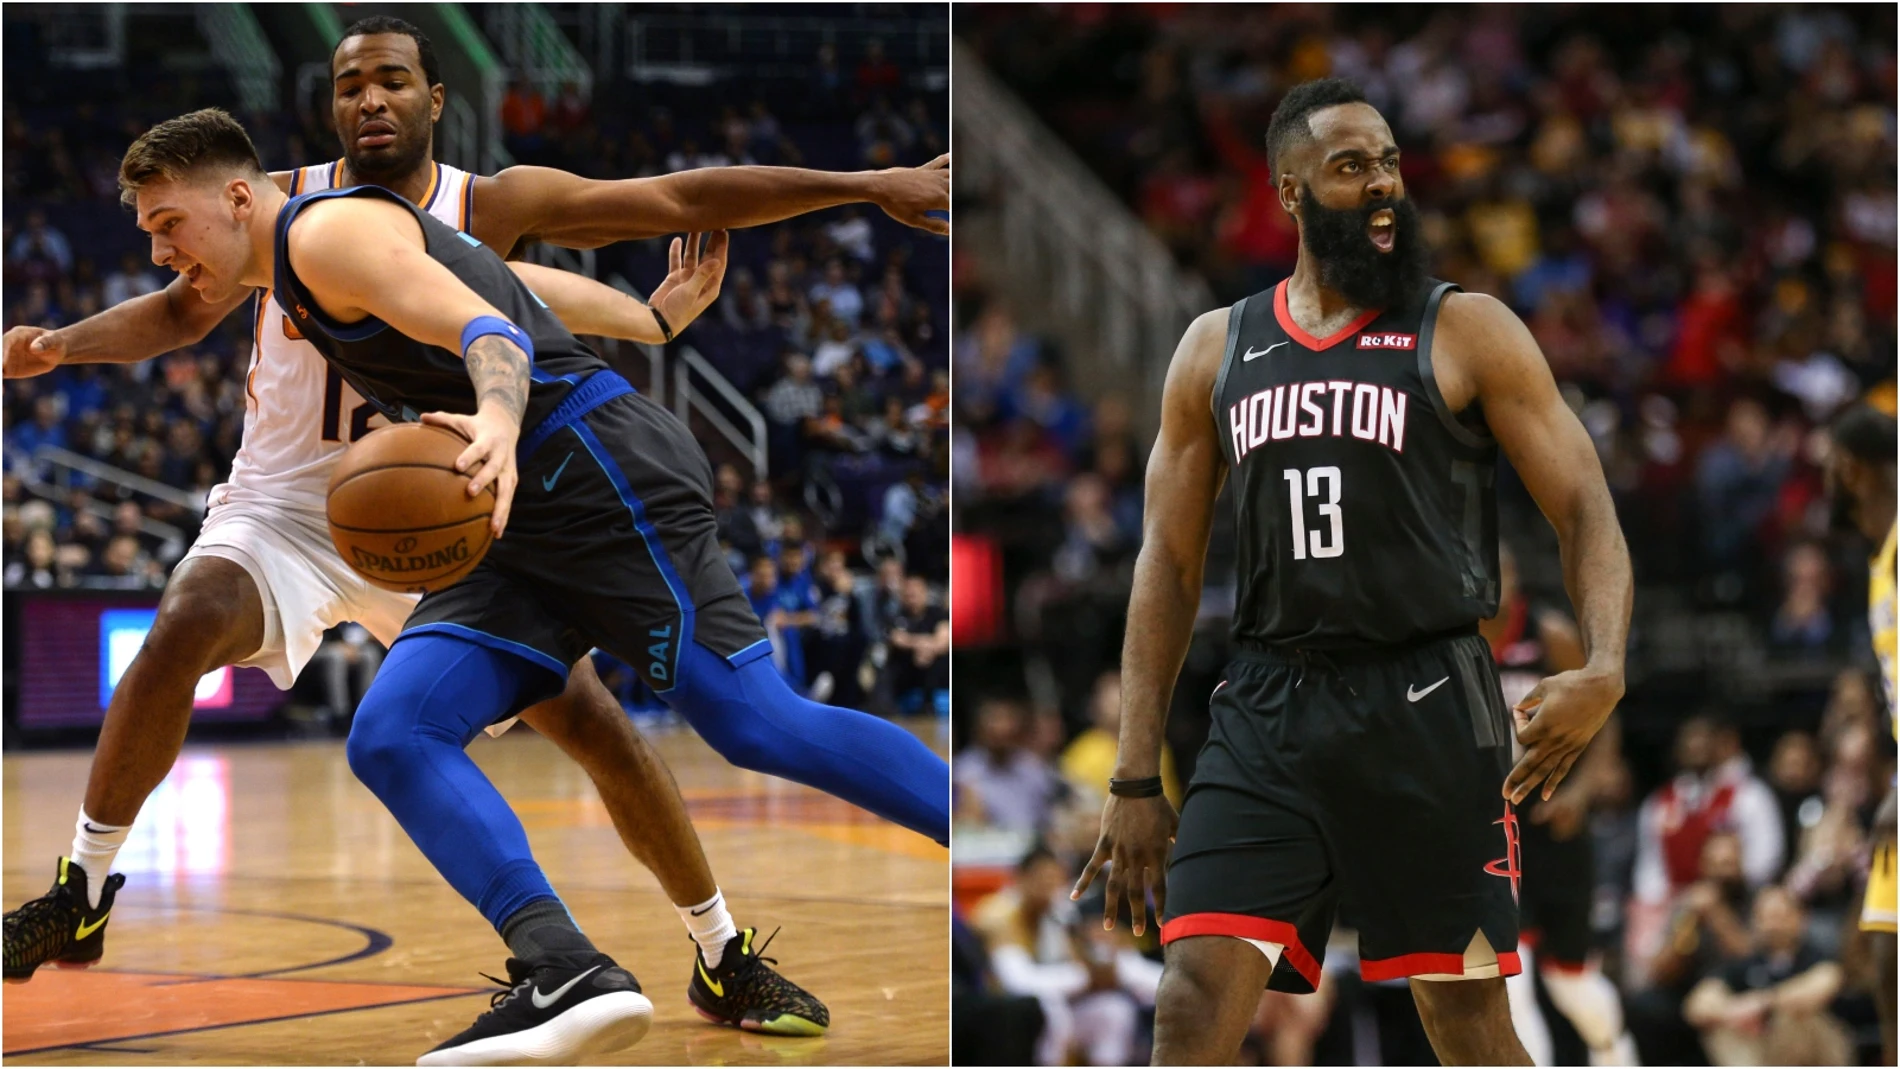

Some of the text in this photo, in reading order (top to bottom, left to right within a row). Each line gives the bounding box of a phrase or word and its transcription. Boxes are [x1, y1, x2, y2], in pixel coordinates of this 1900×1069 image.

[1229, 380, 1408, 465] HOUSTON
[1283, 465, 1345, 560] 13
[351, 536, 469, 572] SPALDING
[648, 624, 672, 681] DAL
